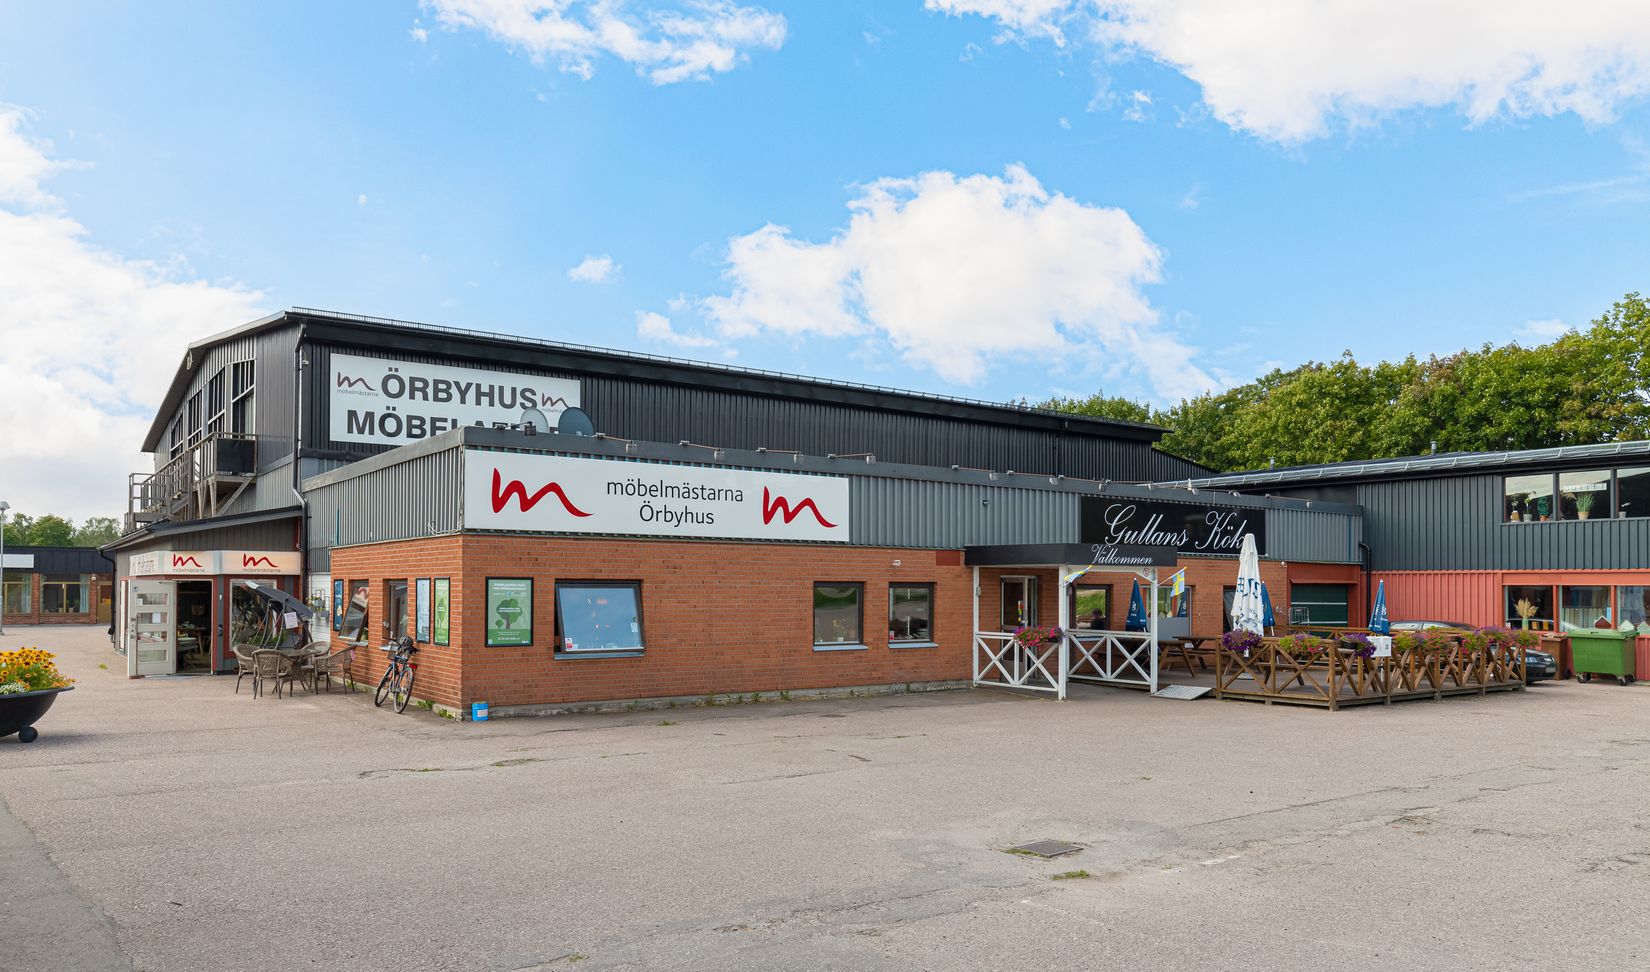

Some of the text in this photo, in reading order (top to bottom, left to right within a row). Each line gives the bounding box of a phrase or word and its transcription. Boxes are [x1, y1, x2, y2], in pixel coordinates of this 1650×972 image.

[381, 367, 538, 411] ÖRBYHUS
[606, 478, 743, 502] möbelmästarna
[639, 500, 715, 528] Örbyhus
[1104, 503, 1248, 550] Gullans Kök
[1091, 544, 1154, 565] Välkommen
